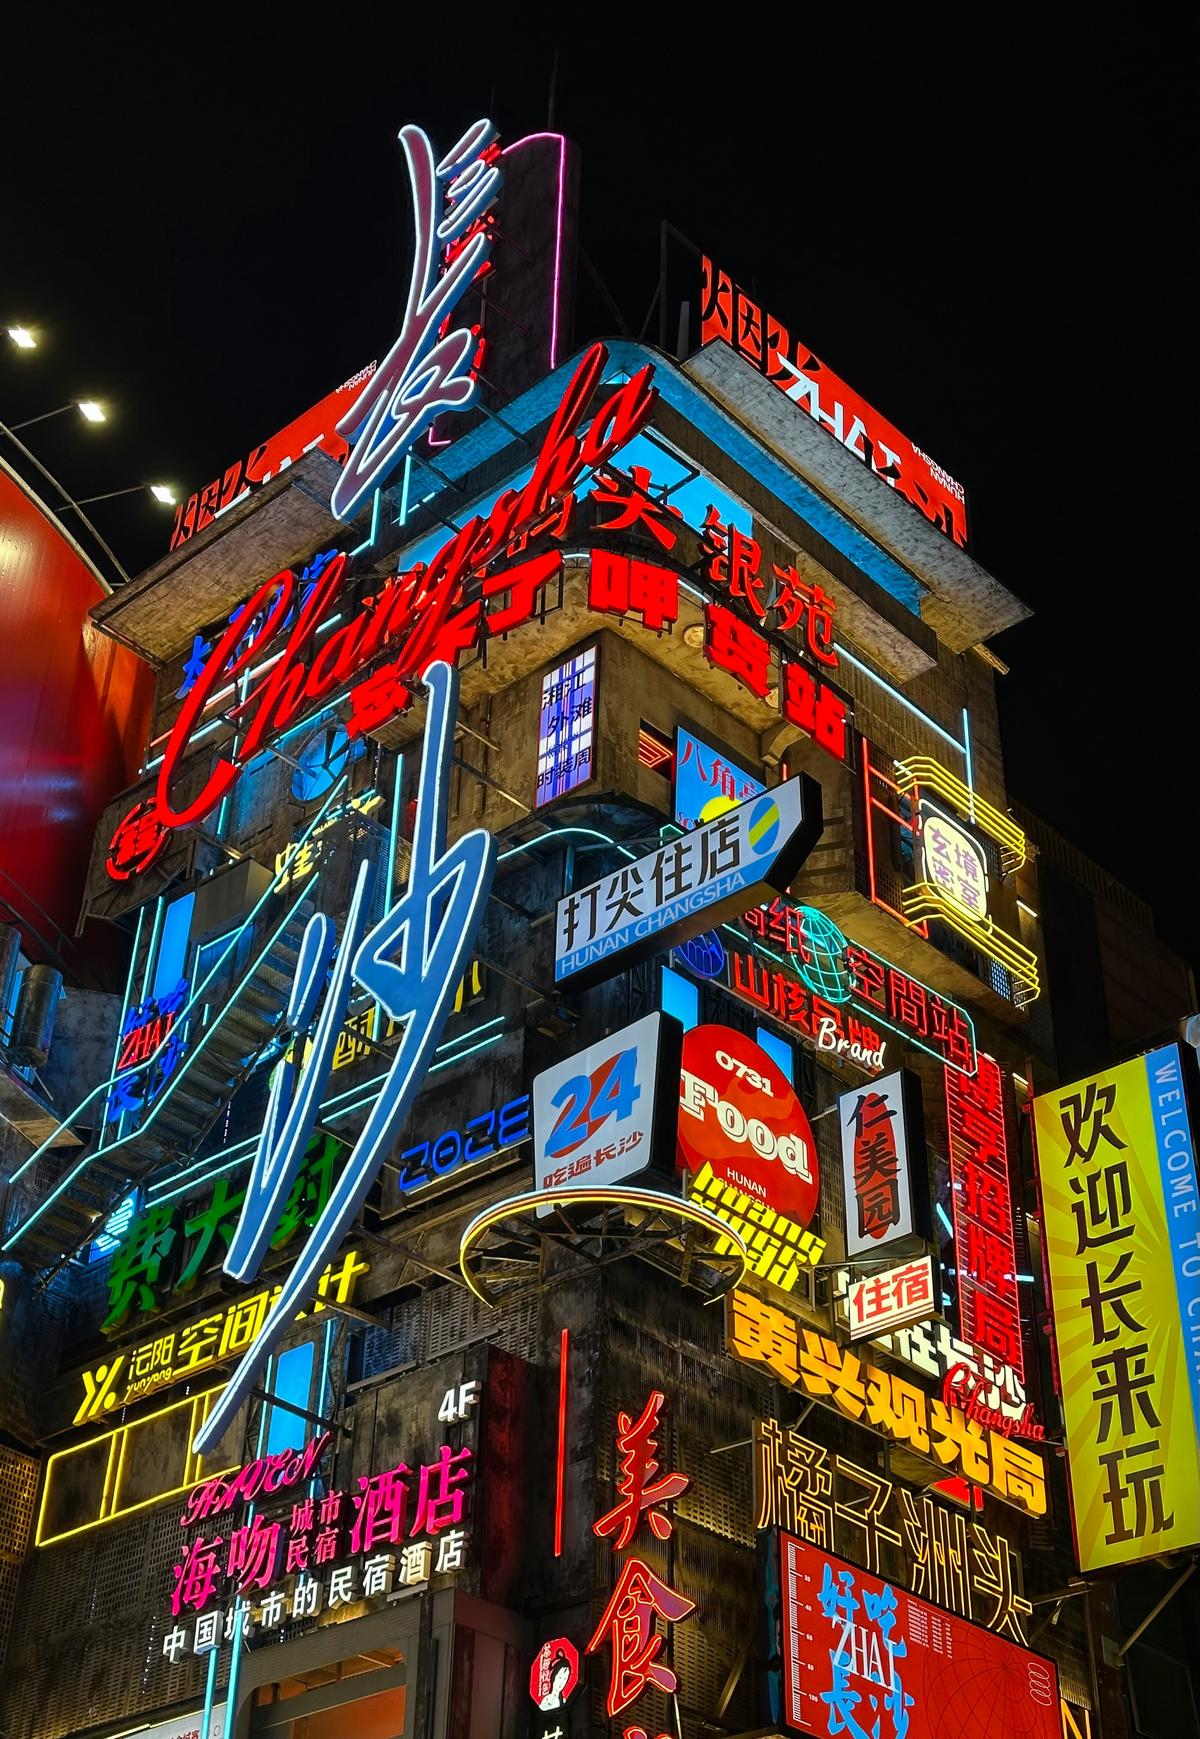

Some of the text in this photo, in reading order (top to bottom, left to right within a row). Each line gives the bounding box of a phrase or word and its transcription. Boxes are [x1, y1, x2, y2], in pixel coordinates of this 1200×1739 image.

[930, 467, 965, 504] HUNAN
[155, 341, 659, 829] Changsha
[541, 670, 586, 711] 湘江
[547, 697, 593, 737] 外滩
[537, 747, 592, 789] 时装周
[563, 815, 740, 952] 打尖住店
[561, 873, 746, 975] HUNAN CHANGSHA
[715, 1050, 774, 1098] 0731
[817, 1016, 887, 1069] Brand
[544, 1045, 642, 1158] 24
[680, 1068, 813, 1185] Food
[1154, 1060, 1198, 1218] WELCOME
[542, 1130, 644, 1188] 吃遍长沙
[727, 1167, 767, 1198] HUNAN
[847, 1093, 902, 1240] 仁美园
[852, 1262, 930, 1323] 住宿
[1059, 1082, 1174, 1546] 欢迎长来玩
[438, 1381, 480, 1423] 4F
[732, 1290, 1047, 1516] 黄兴观光局
[942, 1362, 1046, 1441] Changsha
[289, 1489, 343, 1537] 城市
[350, 1445, 475, 1554] 酒店
[757, 1417, 1033, 1648] 橘子洲头
[171, 1513, 284, 1616] 海吻
[286, 1527, 340, 1574] 民宿
[584, 1390, 697, 1739] 美食
[162, 1530, 468, 1663] 中国城市的民宿酒店
[831, 1614, 900, 1694] ZHAI
[807, 1692, 819, 1703] 100
